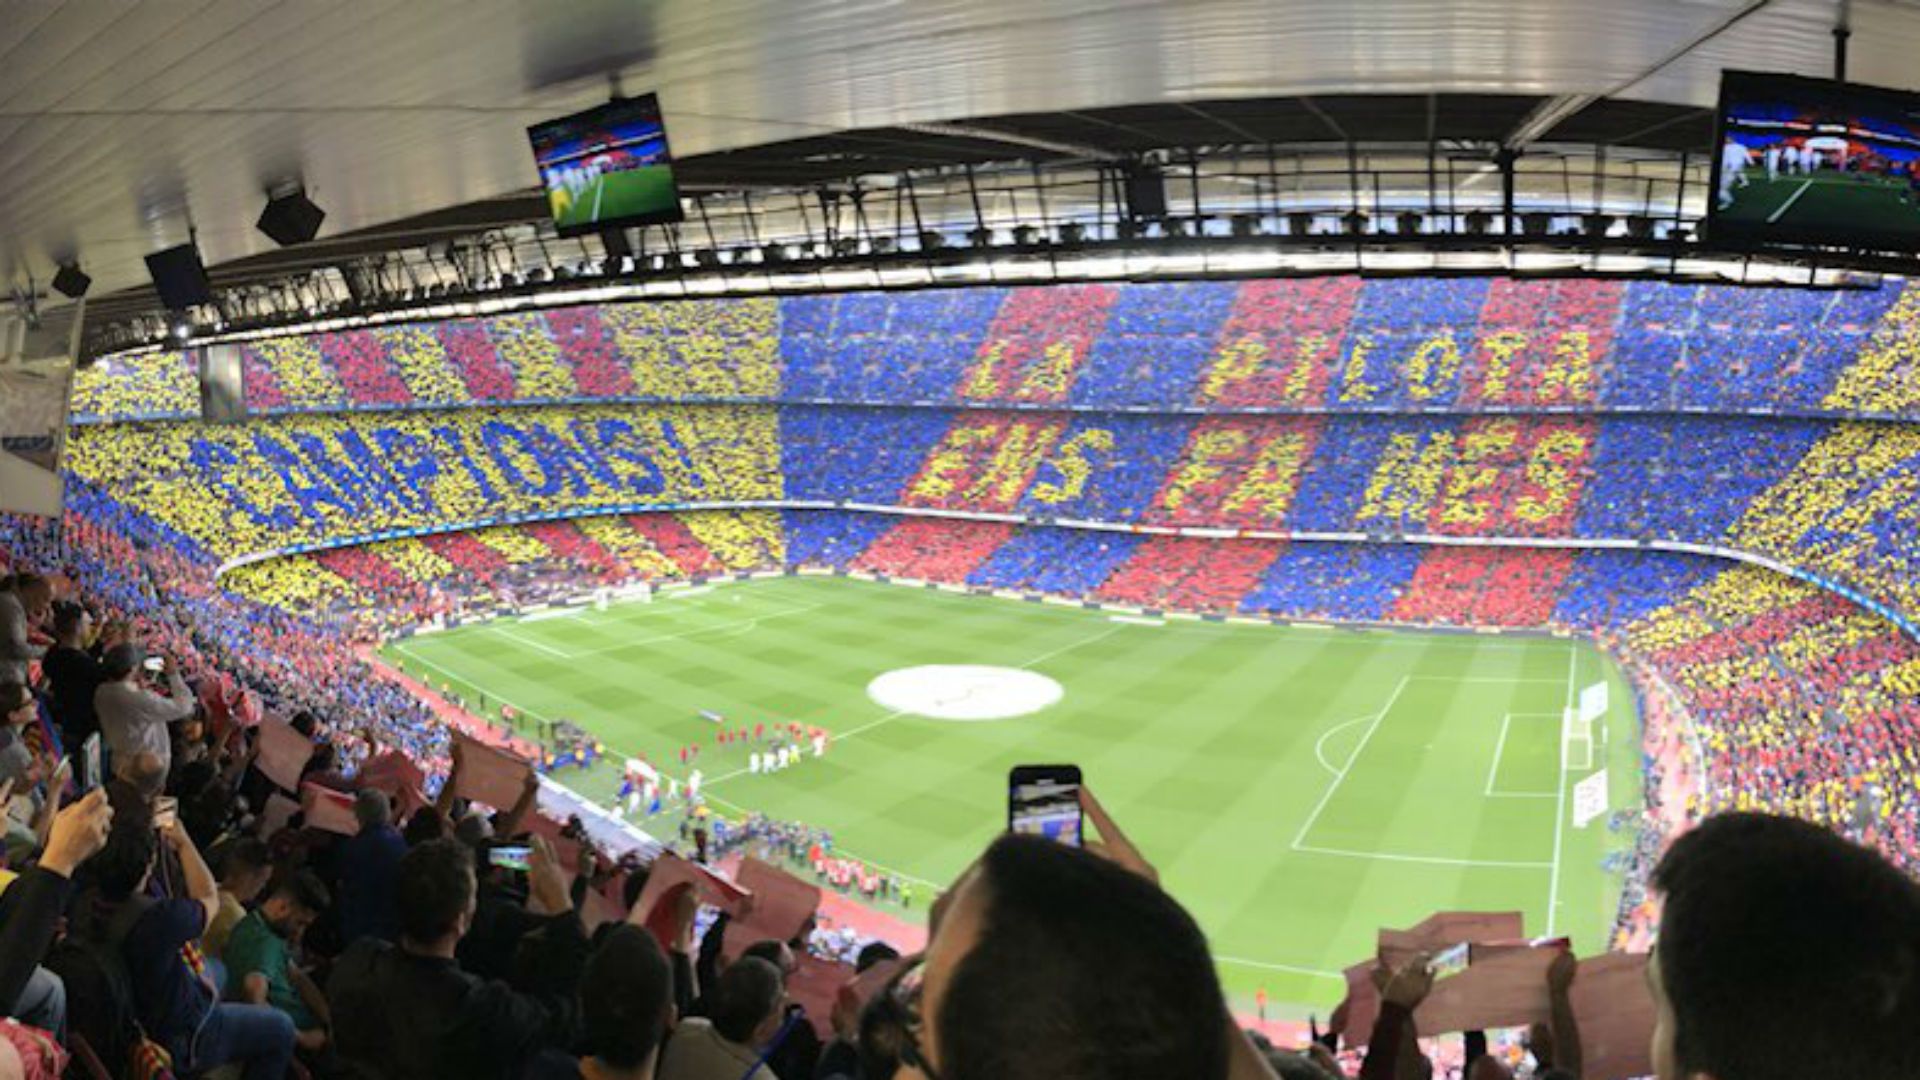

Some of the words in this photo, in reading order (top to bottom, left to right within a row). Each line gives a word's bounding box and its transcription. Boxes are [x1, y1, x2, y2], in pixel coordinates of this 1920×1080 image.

[965, 338, 1075, 399] LA
[1204, 333, 1590, 401] PILOTA
[907, 424, 1115, 502] ENS
